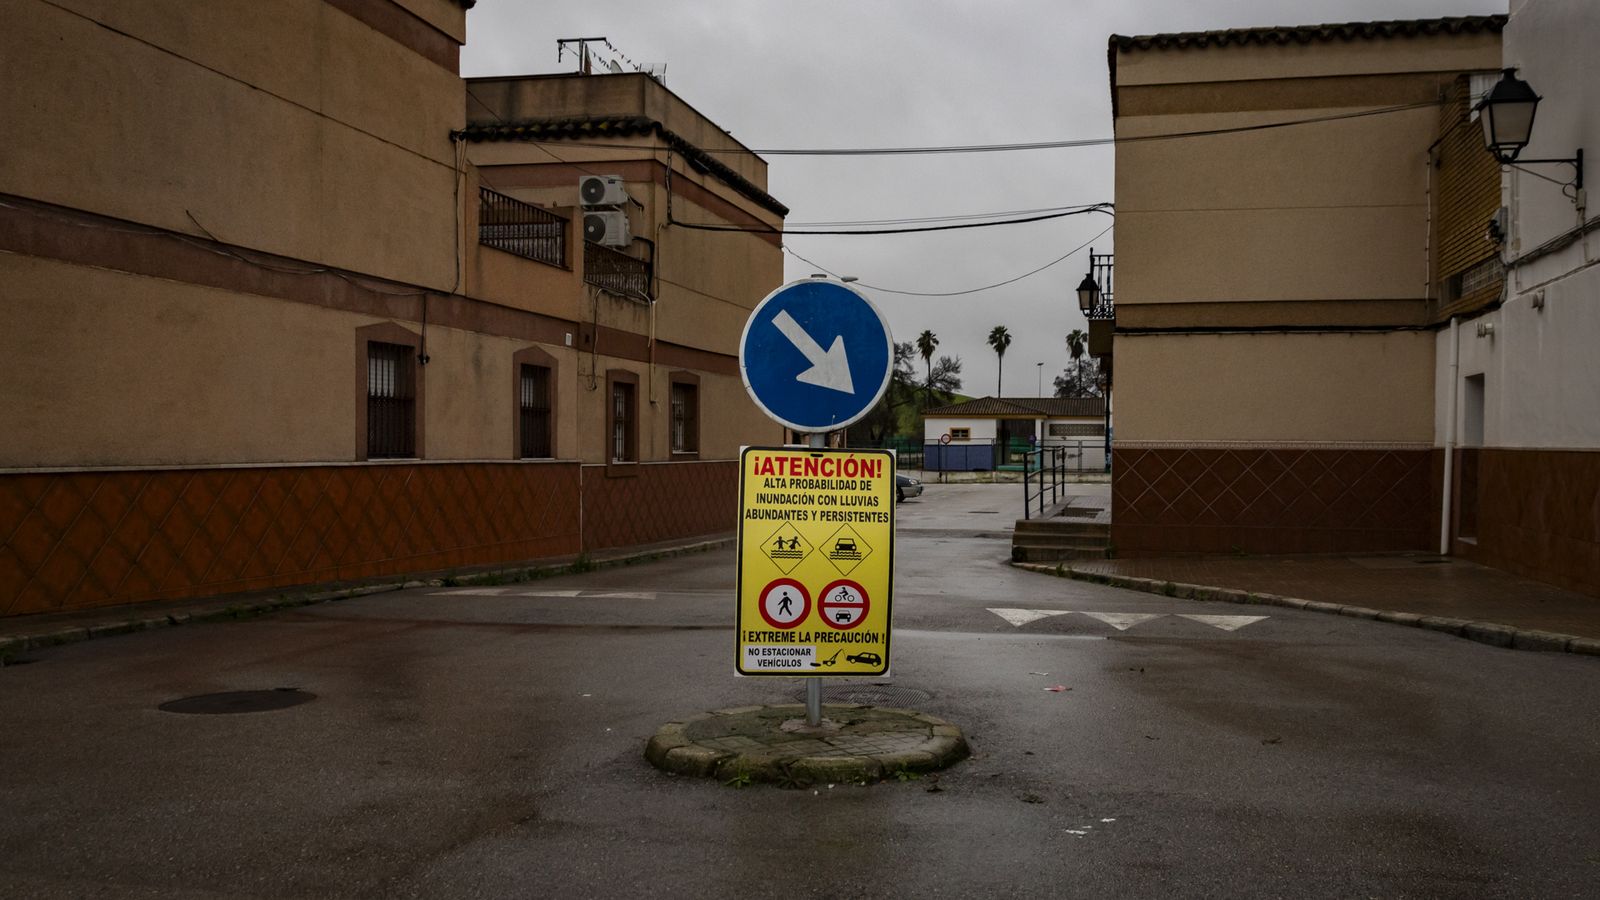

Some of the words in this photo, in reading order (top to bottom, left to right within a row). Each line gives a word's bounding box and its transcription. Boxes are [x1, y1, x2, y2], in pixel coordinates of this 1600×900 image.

[754, 454, 882, 478] ¡ATENCIÓN!
[764, 478, 787, 488] ALTA
[790, 479, 857, 490] PROBABILIDAD
[860, 481, 871, 490] DE
[756, 492, 814, 505] INUNDACIÓN
[818, 495, 837, 505] CON
[840, 496, 879, 506] LLUVIAS
[746, 509, 808, 521] ABUNDANTES
[811, 511, 817, 521] Y
[820, 511, 888, 522] PERSISTENTES
[799, 632, 811, 643] LA
[749, 648, 760, 656] NO
[762, 648, 811, 656] ESTACIONAR
[757, 658, 802, 667] VEHÍCULOS
